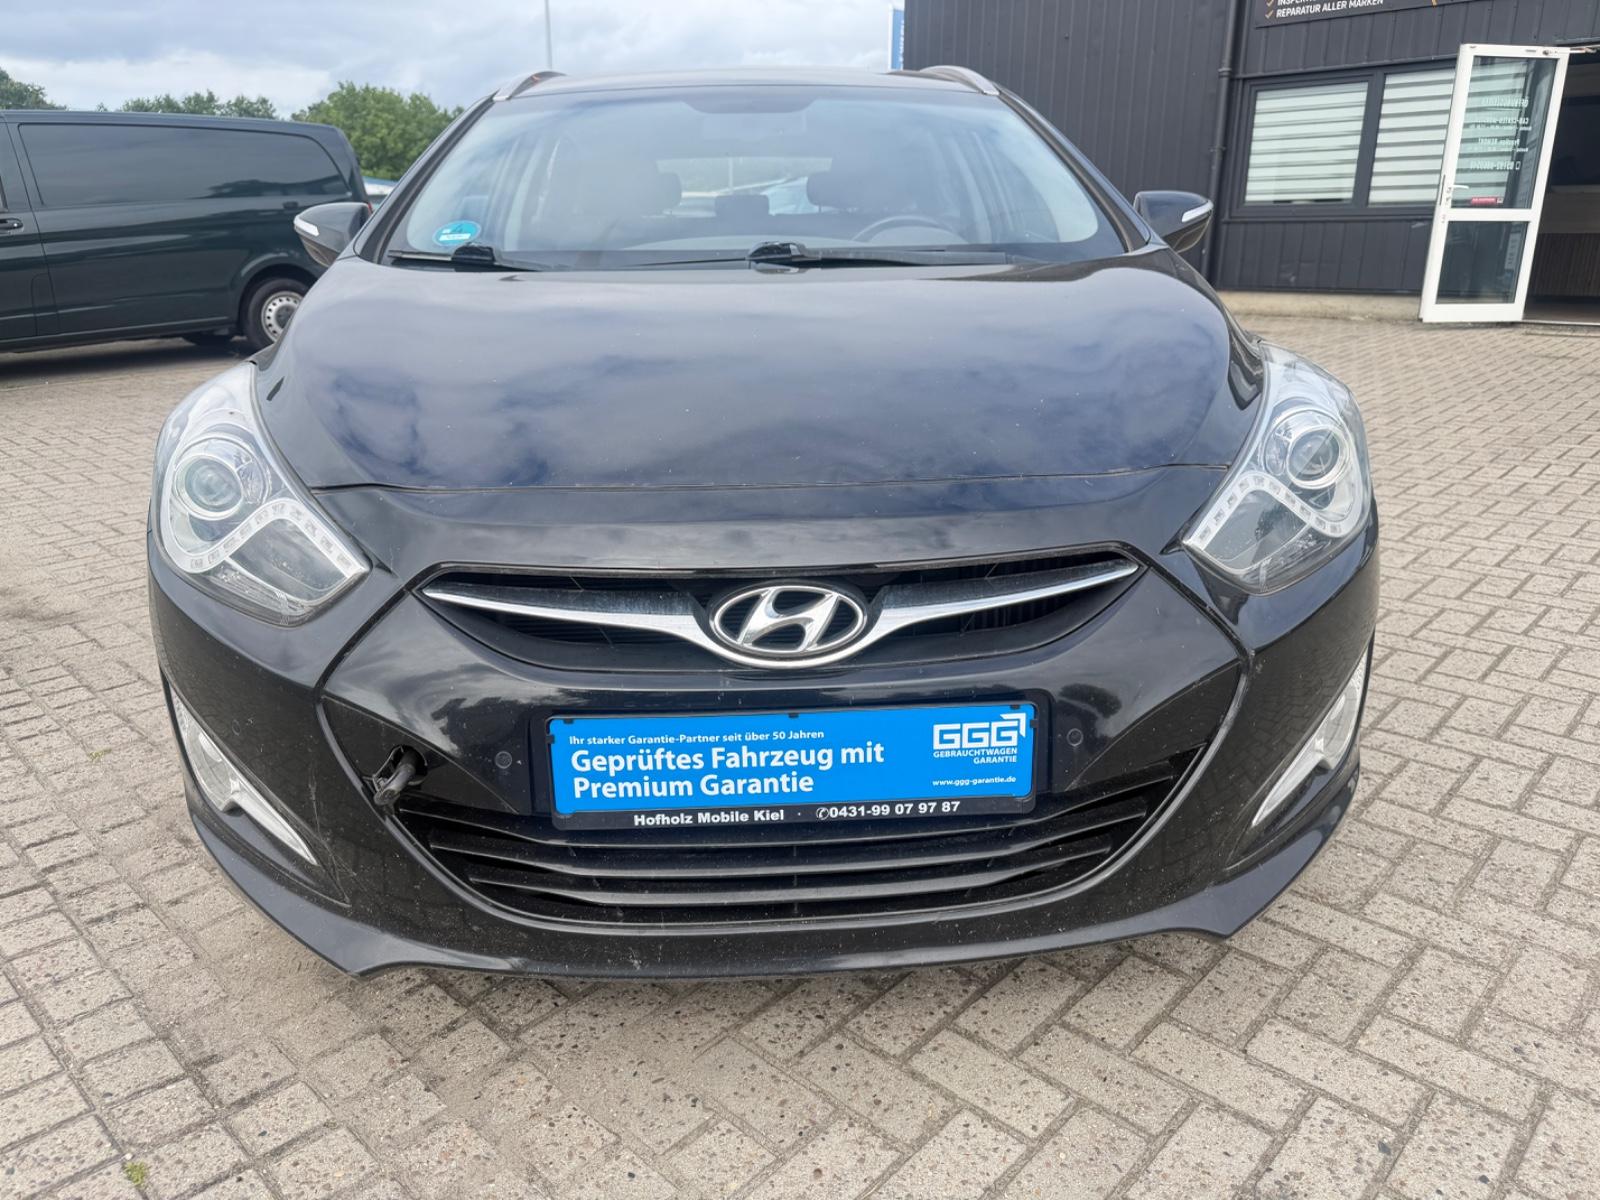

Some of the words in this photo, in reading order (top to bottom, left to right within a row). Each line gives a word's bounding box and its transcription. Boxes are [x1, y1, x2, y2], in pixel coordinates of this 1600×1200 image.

[1276, 4, 1321, 18] REPARATUR
[1321, 2, 1347, 12] ALLER
[1348, 0, 1384, 9] MARKEN
[569, 736, 584, 745] Ihr
[587, 735, 625, 745] starker
[628, 733, 720, 745] Garantie-Partner
[722, 733, 742, 743] seit
[744, 731, 769, 742] über
[772, 731, 786, 740] 50
[787, 730, 825, 740] Jahren
[933, 720, 1018, 750] GGG
[571, 748, 704, 777] Geprüftes
[711, 745, 833, 770] Fahrzeug
[841, 741, 884, 764] mit
[933, 747, 1018, 758] GEBRAUCHTWAGEN
[973, 755, 1017, 765] GARANTIE
[573, 776, 693, 799] Premium
[700, 771, 814, 796] Garantie
[932, 776, 1017, 786] www.ggg-garantie.de
[634, 814, 693, 827] Hofholz
[697, 811, 750, 824] Mobile
[753, 809, 784, 822] Kiel
[829, 804, 890, 819] 0431-99
[894, 803, 914, 816] 07
[918, 802, 937, 815] 97
[941, 801, 960, 813] 87
